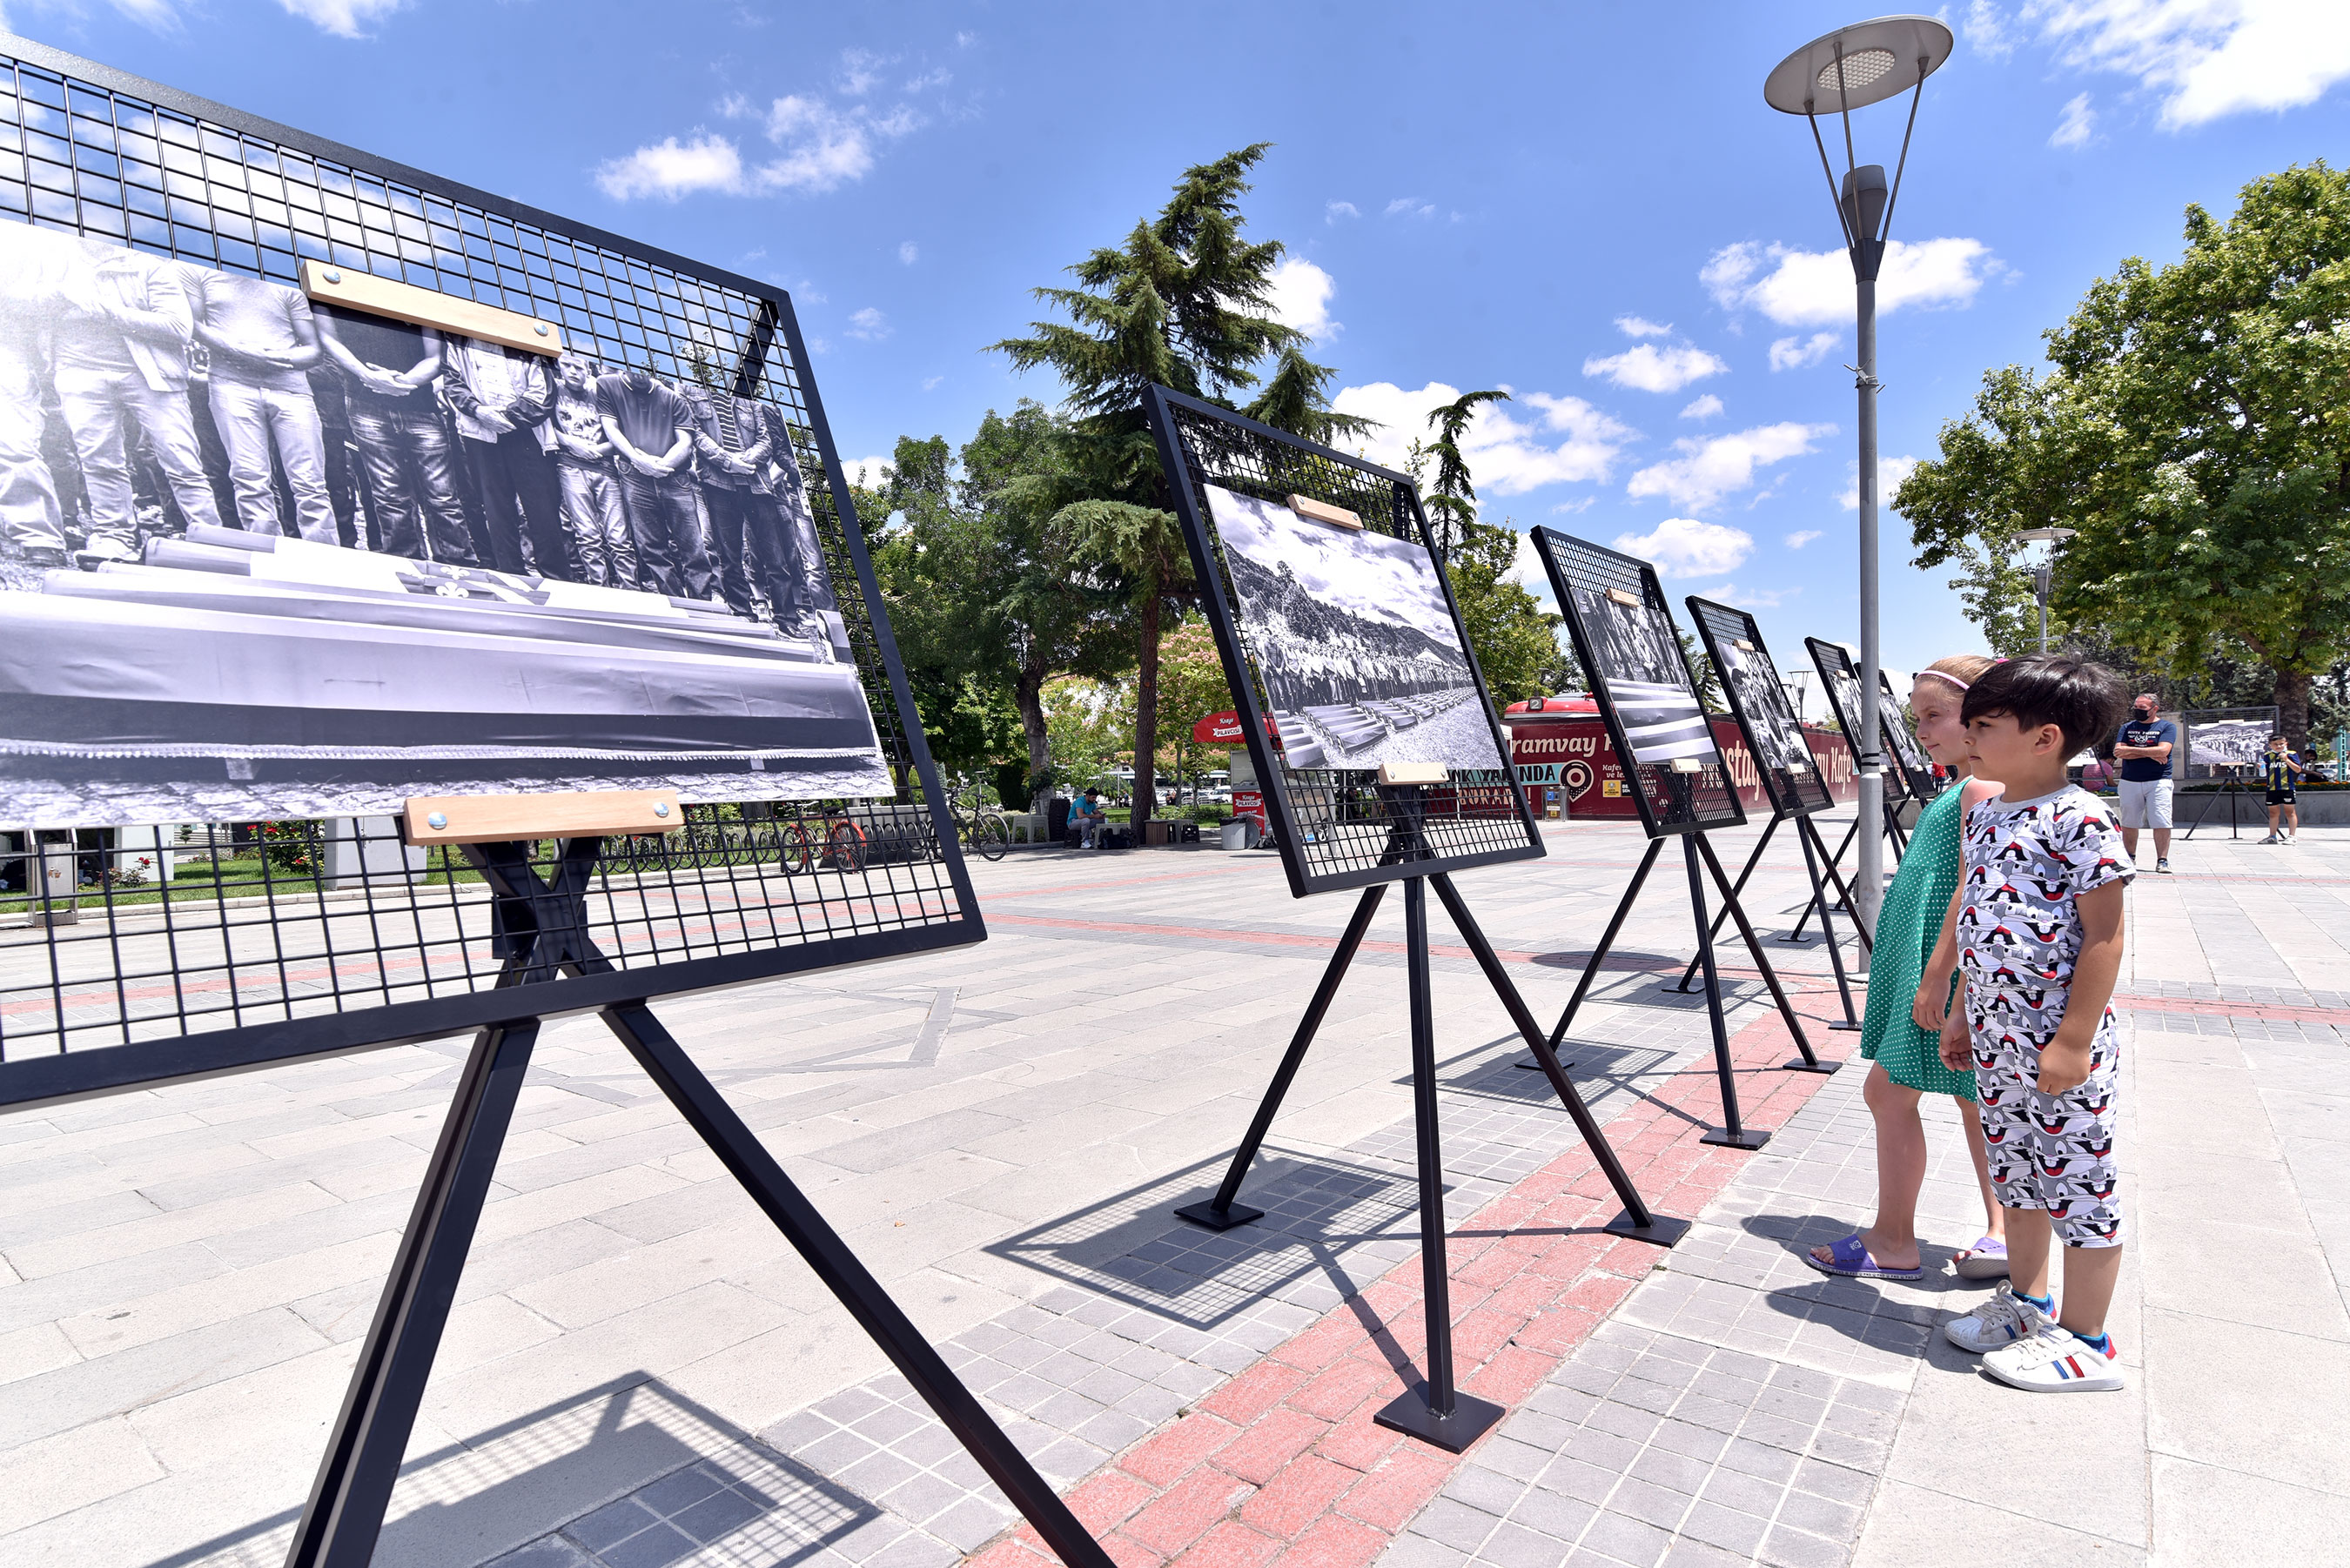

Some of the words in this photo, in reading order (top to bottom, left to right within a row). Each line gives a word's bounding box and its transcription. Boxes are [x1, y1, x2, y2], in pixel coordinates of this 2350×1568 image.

[1530, 700, 1540, 709] 2
[1512, 737, 1596, 758] ramvay
[1830, 744, 1851, 794] Kafe
